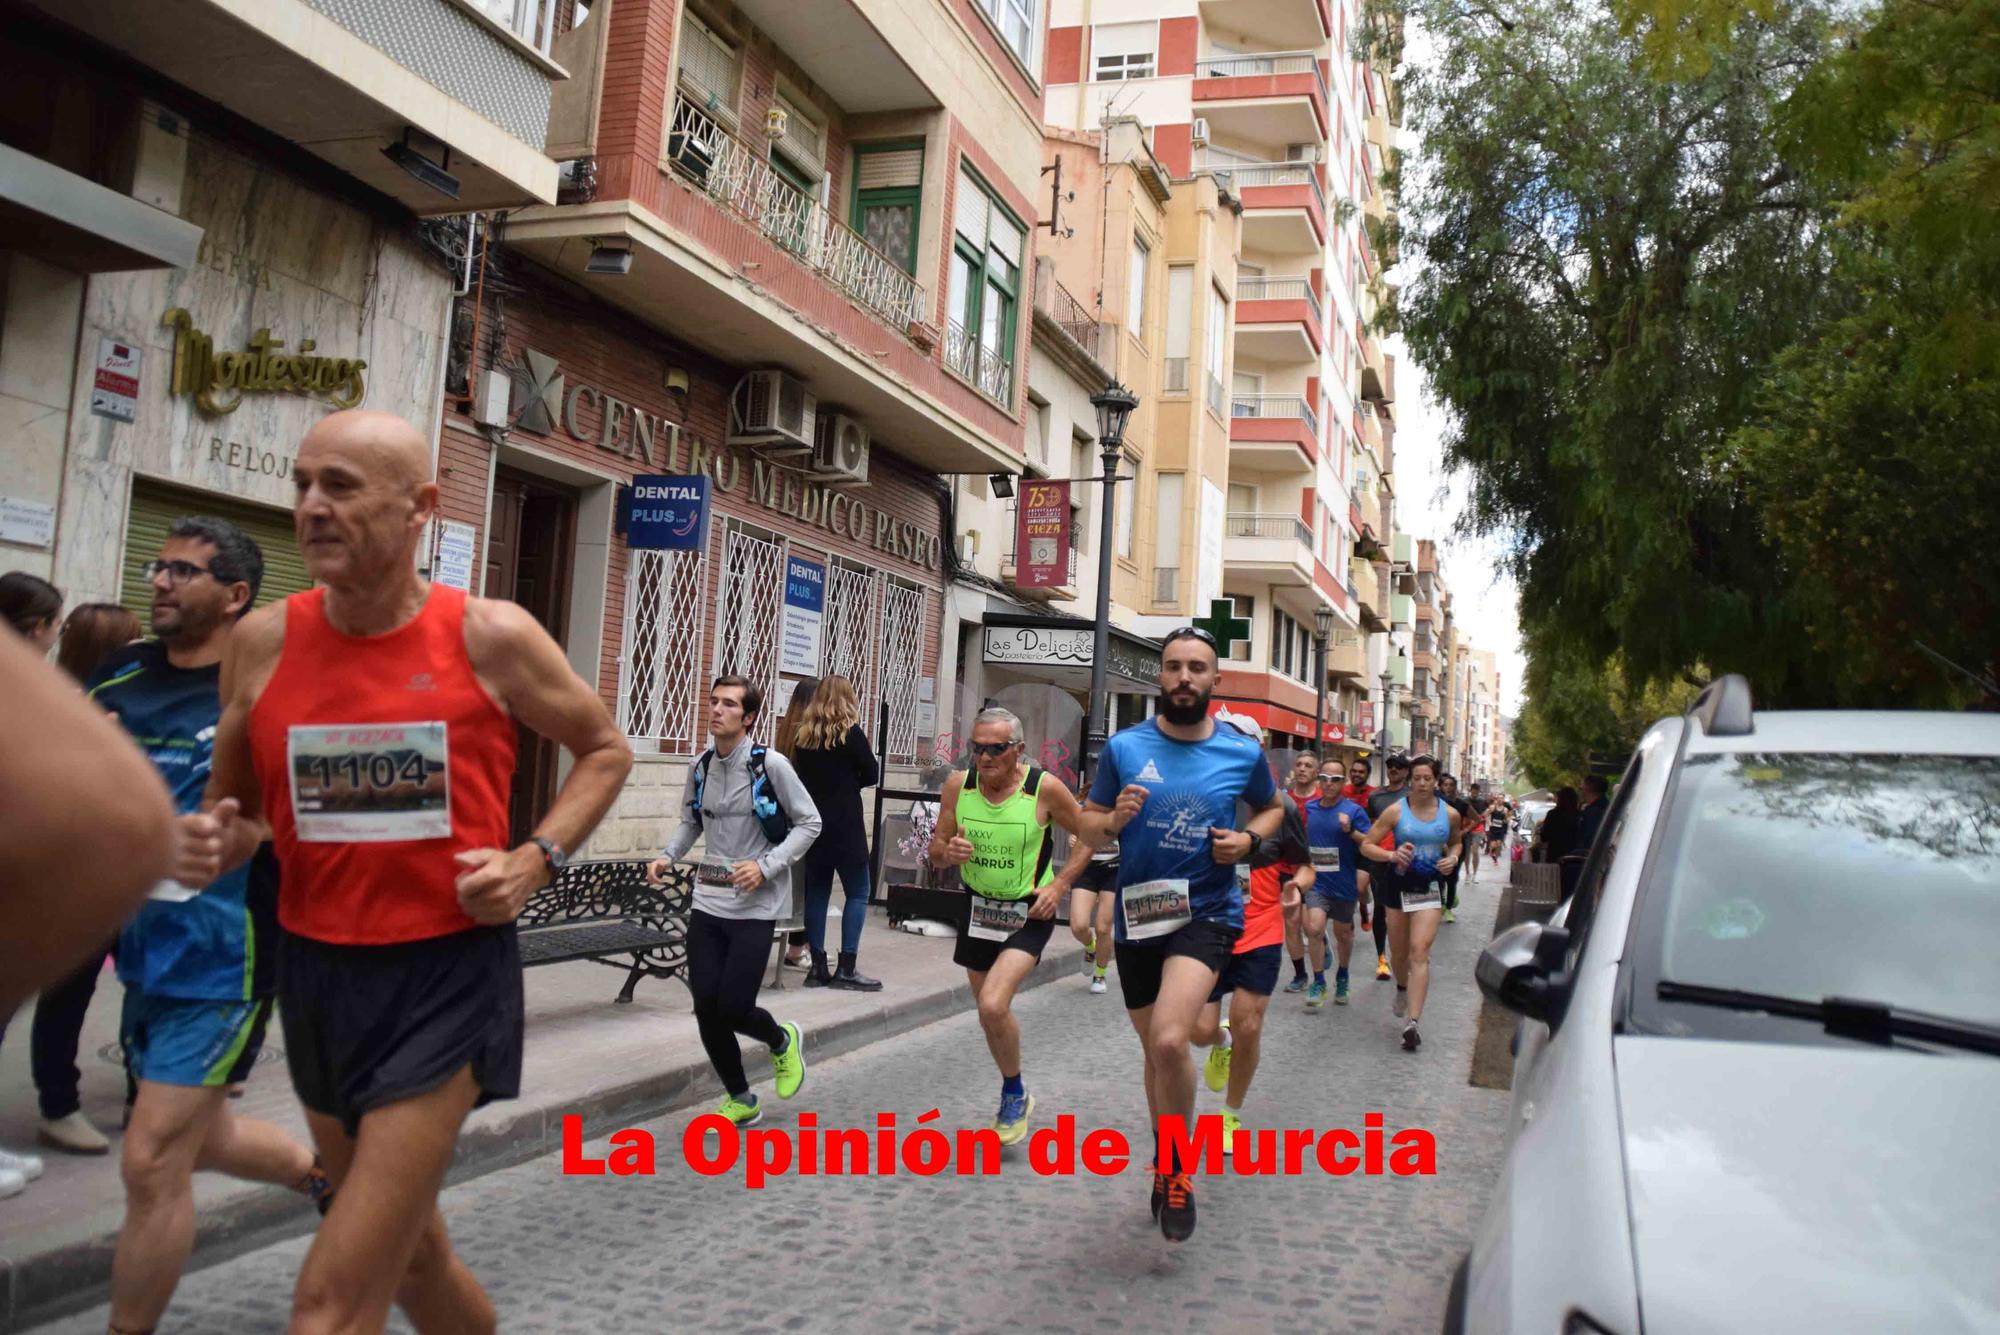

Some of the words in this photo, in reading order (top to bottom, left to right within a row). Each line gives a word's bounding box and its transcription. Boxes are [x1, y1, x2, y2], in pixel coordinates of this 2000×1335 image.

[161, 307, 367, 416] Montesinos
[565, 384, 740, 493] CENTRO
[873, 509, 943, 571] PASEO
[634, 486, 701, 500] DENTAL
[631, 509, 675, 523] PLUS
[1027, 524, 1061, 534] CIEZA
[790, 563, 822, 584] DENTAL
[788, 583, 811, 600] PLUS
[985, 629, 1012, 658] Las
[1016, 629, 1094, 654] Delicias
[310, 751, 430, 792] 1104
[967, 829, 993, 840] XXXV
[973, 843, 998, 855] ROSS
[1000, 846, 1014, 855] DE
[1134, 891, 1180, 916] 1175
[981, 907, 1020, 925] 1047
